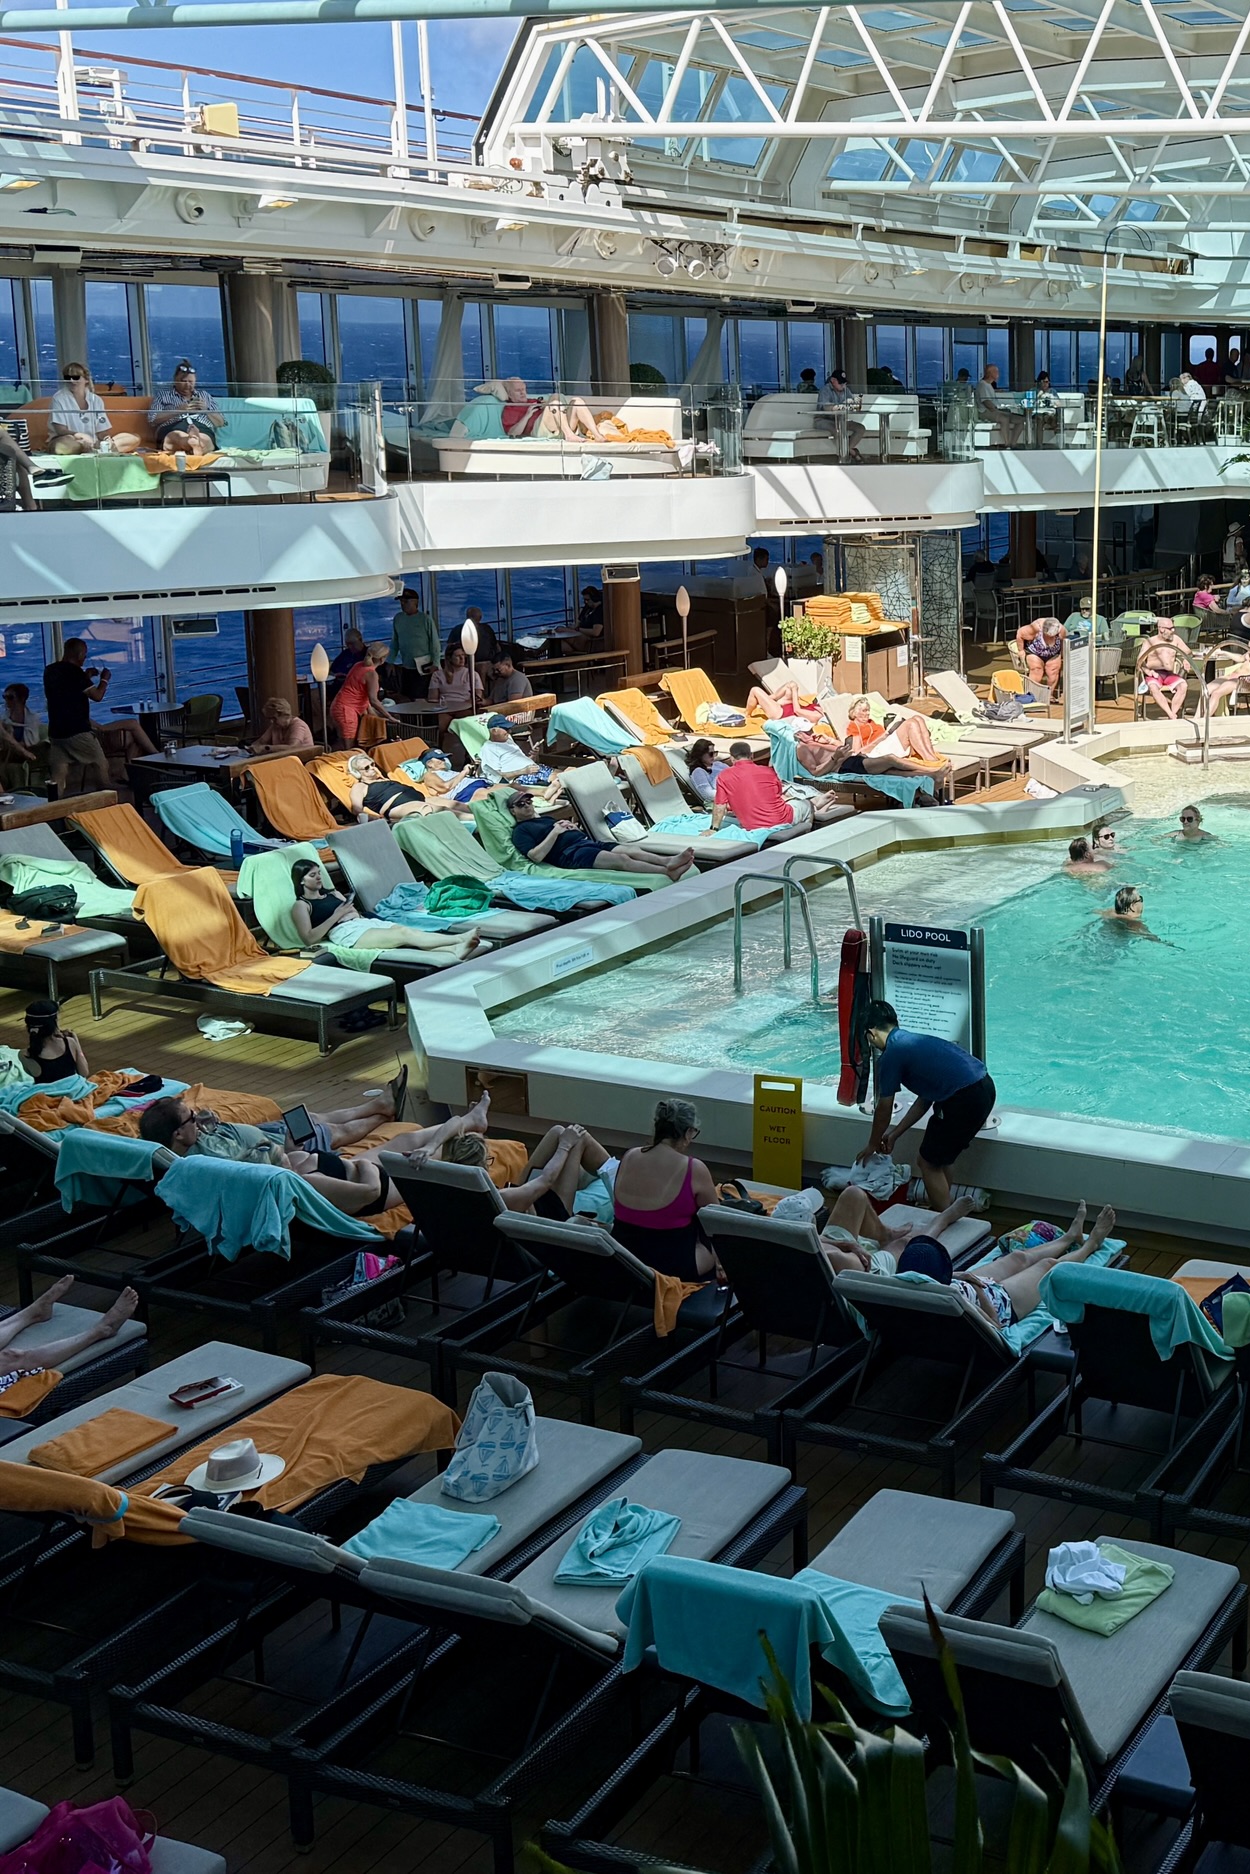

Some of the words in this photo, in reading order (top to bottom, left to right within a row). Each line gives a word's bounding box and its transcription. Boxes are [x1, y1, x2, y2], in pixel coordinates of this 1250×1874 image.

[900, 928, 923, 939] LIDO
[925, 931, 952, 942] POOL
[759, 1105, 796, 1115] CAUTION
[769, 1125, 787, 1133] WET
[763, 1136, 791, 1145] FLOOR
